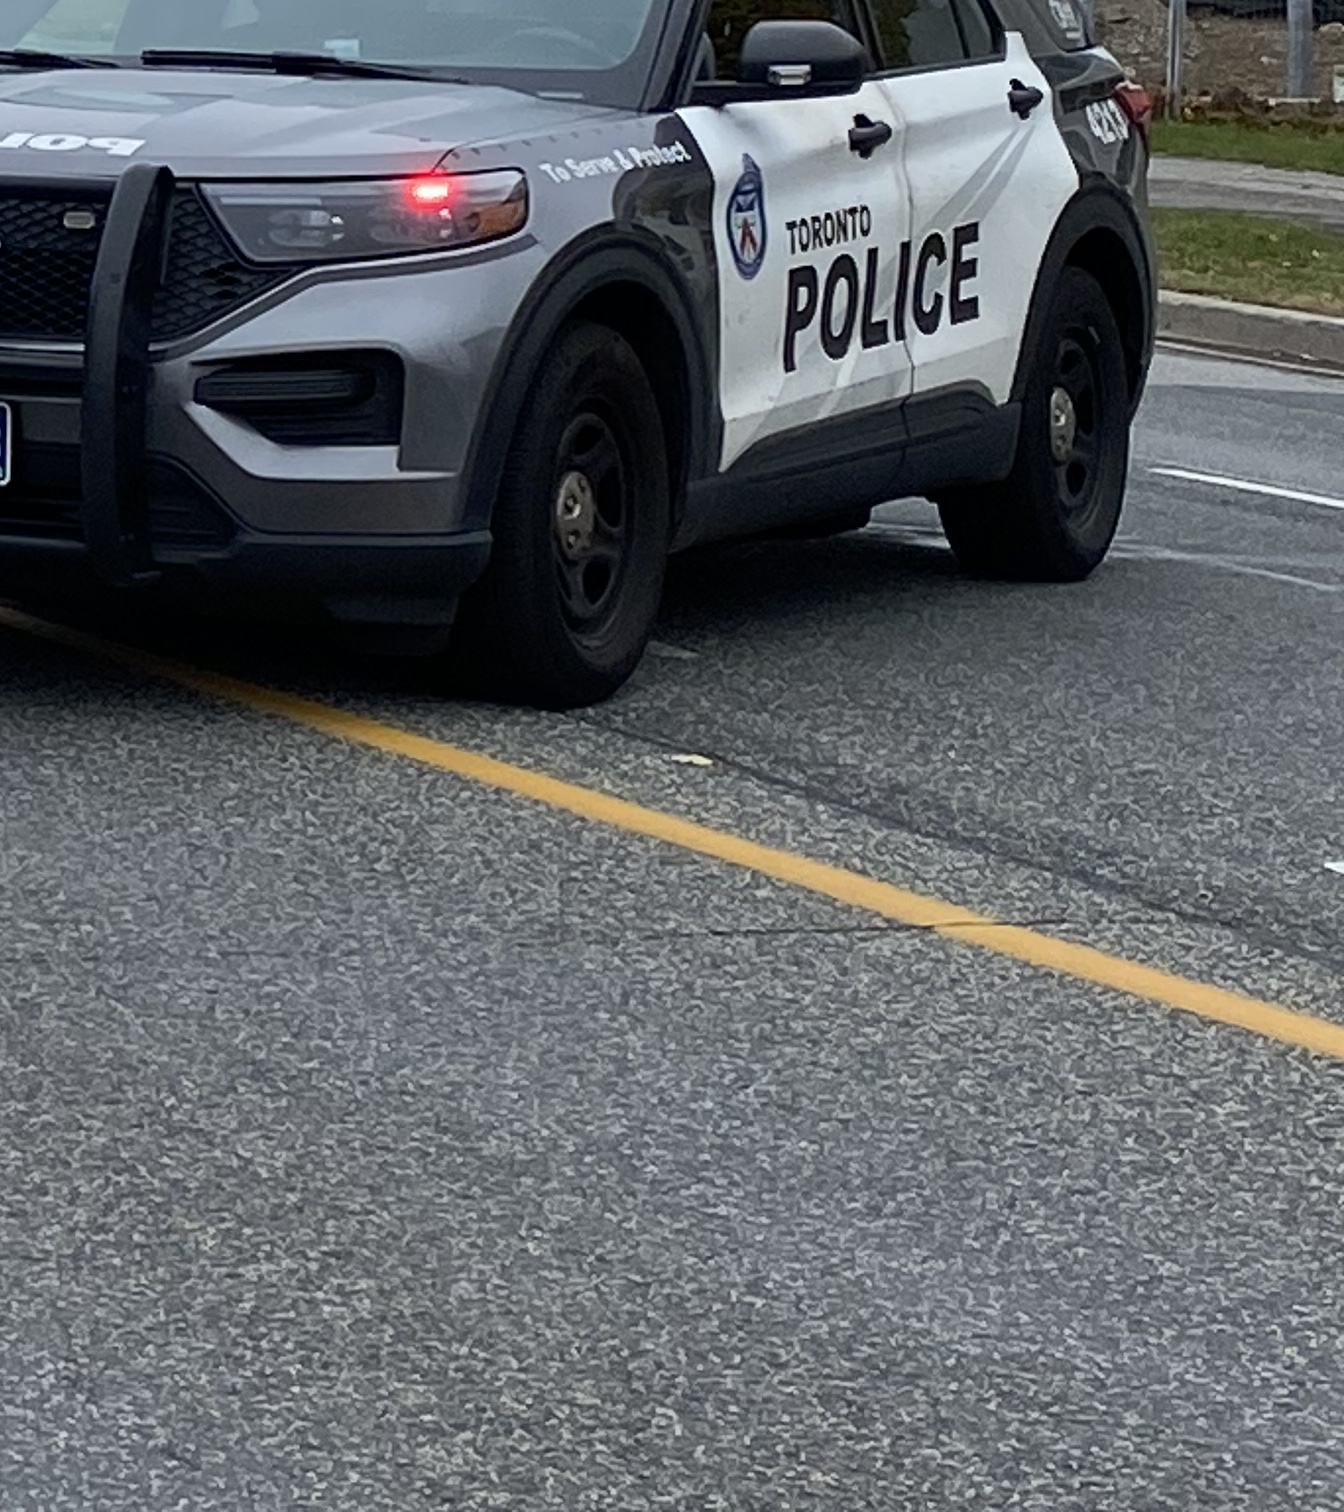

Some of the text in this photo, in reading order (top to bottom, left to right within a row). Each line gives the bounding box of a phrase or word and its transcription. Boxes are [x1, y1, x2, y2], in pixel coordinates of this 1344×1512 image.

[538, 140, 692, 184] To Serve & Protect
[785, 204, 871, 255] TORONTO
[783, 221, 980, 374] POLICE
